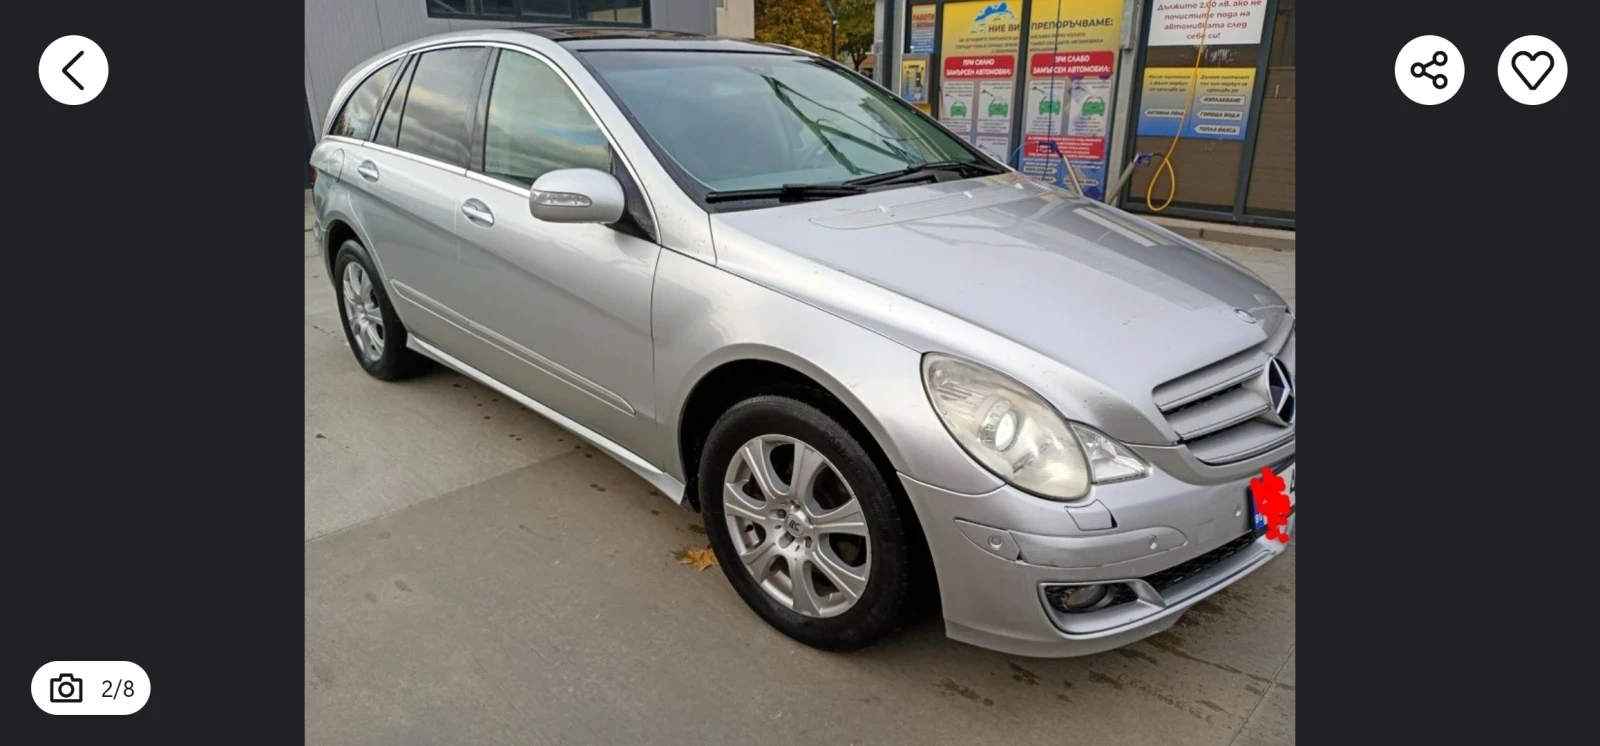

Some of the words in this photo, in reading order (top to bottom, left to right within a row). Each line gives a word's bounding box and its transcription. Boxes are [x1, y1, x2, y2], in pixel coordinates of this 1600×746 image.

[1164, 13, 1215, 21] почистите
[988, 24, 1006, 33] НИЕ
[1008, 23, 1020, 32] ВИ
[1031, 17, 1114, 31] ПРЕПОРЪЧВАМЕ:
[1226, 21, 1248, 29] след
[975, 58, 995, 66] СИЛНО
[1067, 55, 1090, 63] СЛАБО
[1067, 65, 1111, 73] АВТОМОБИЛ:
